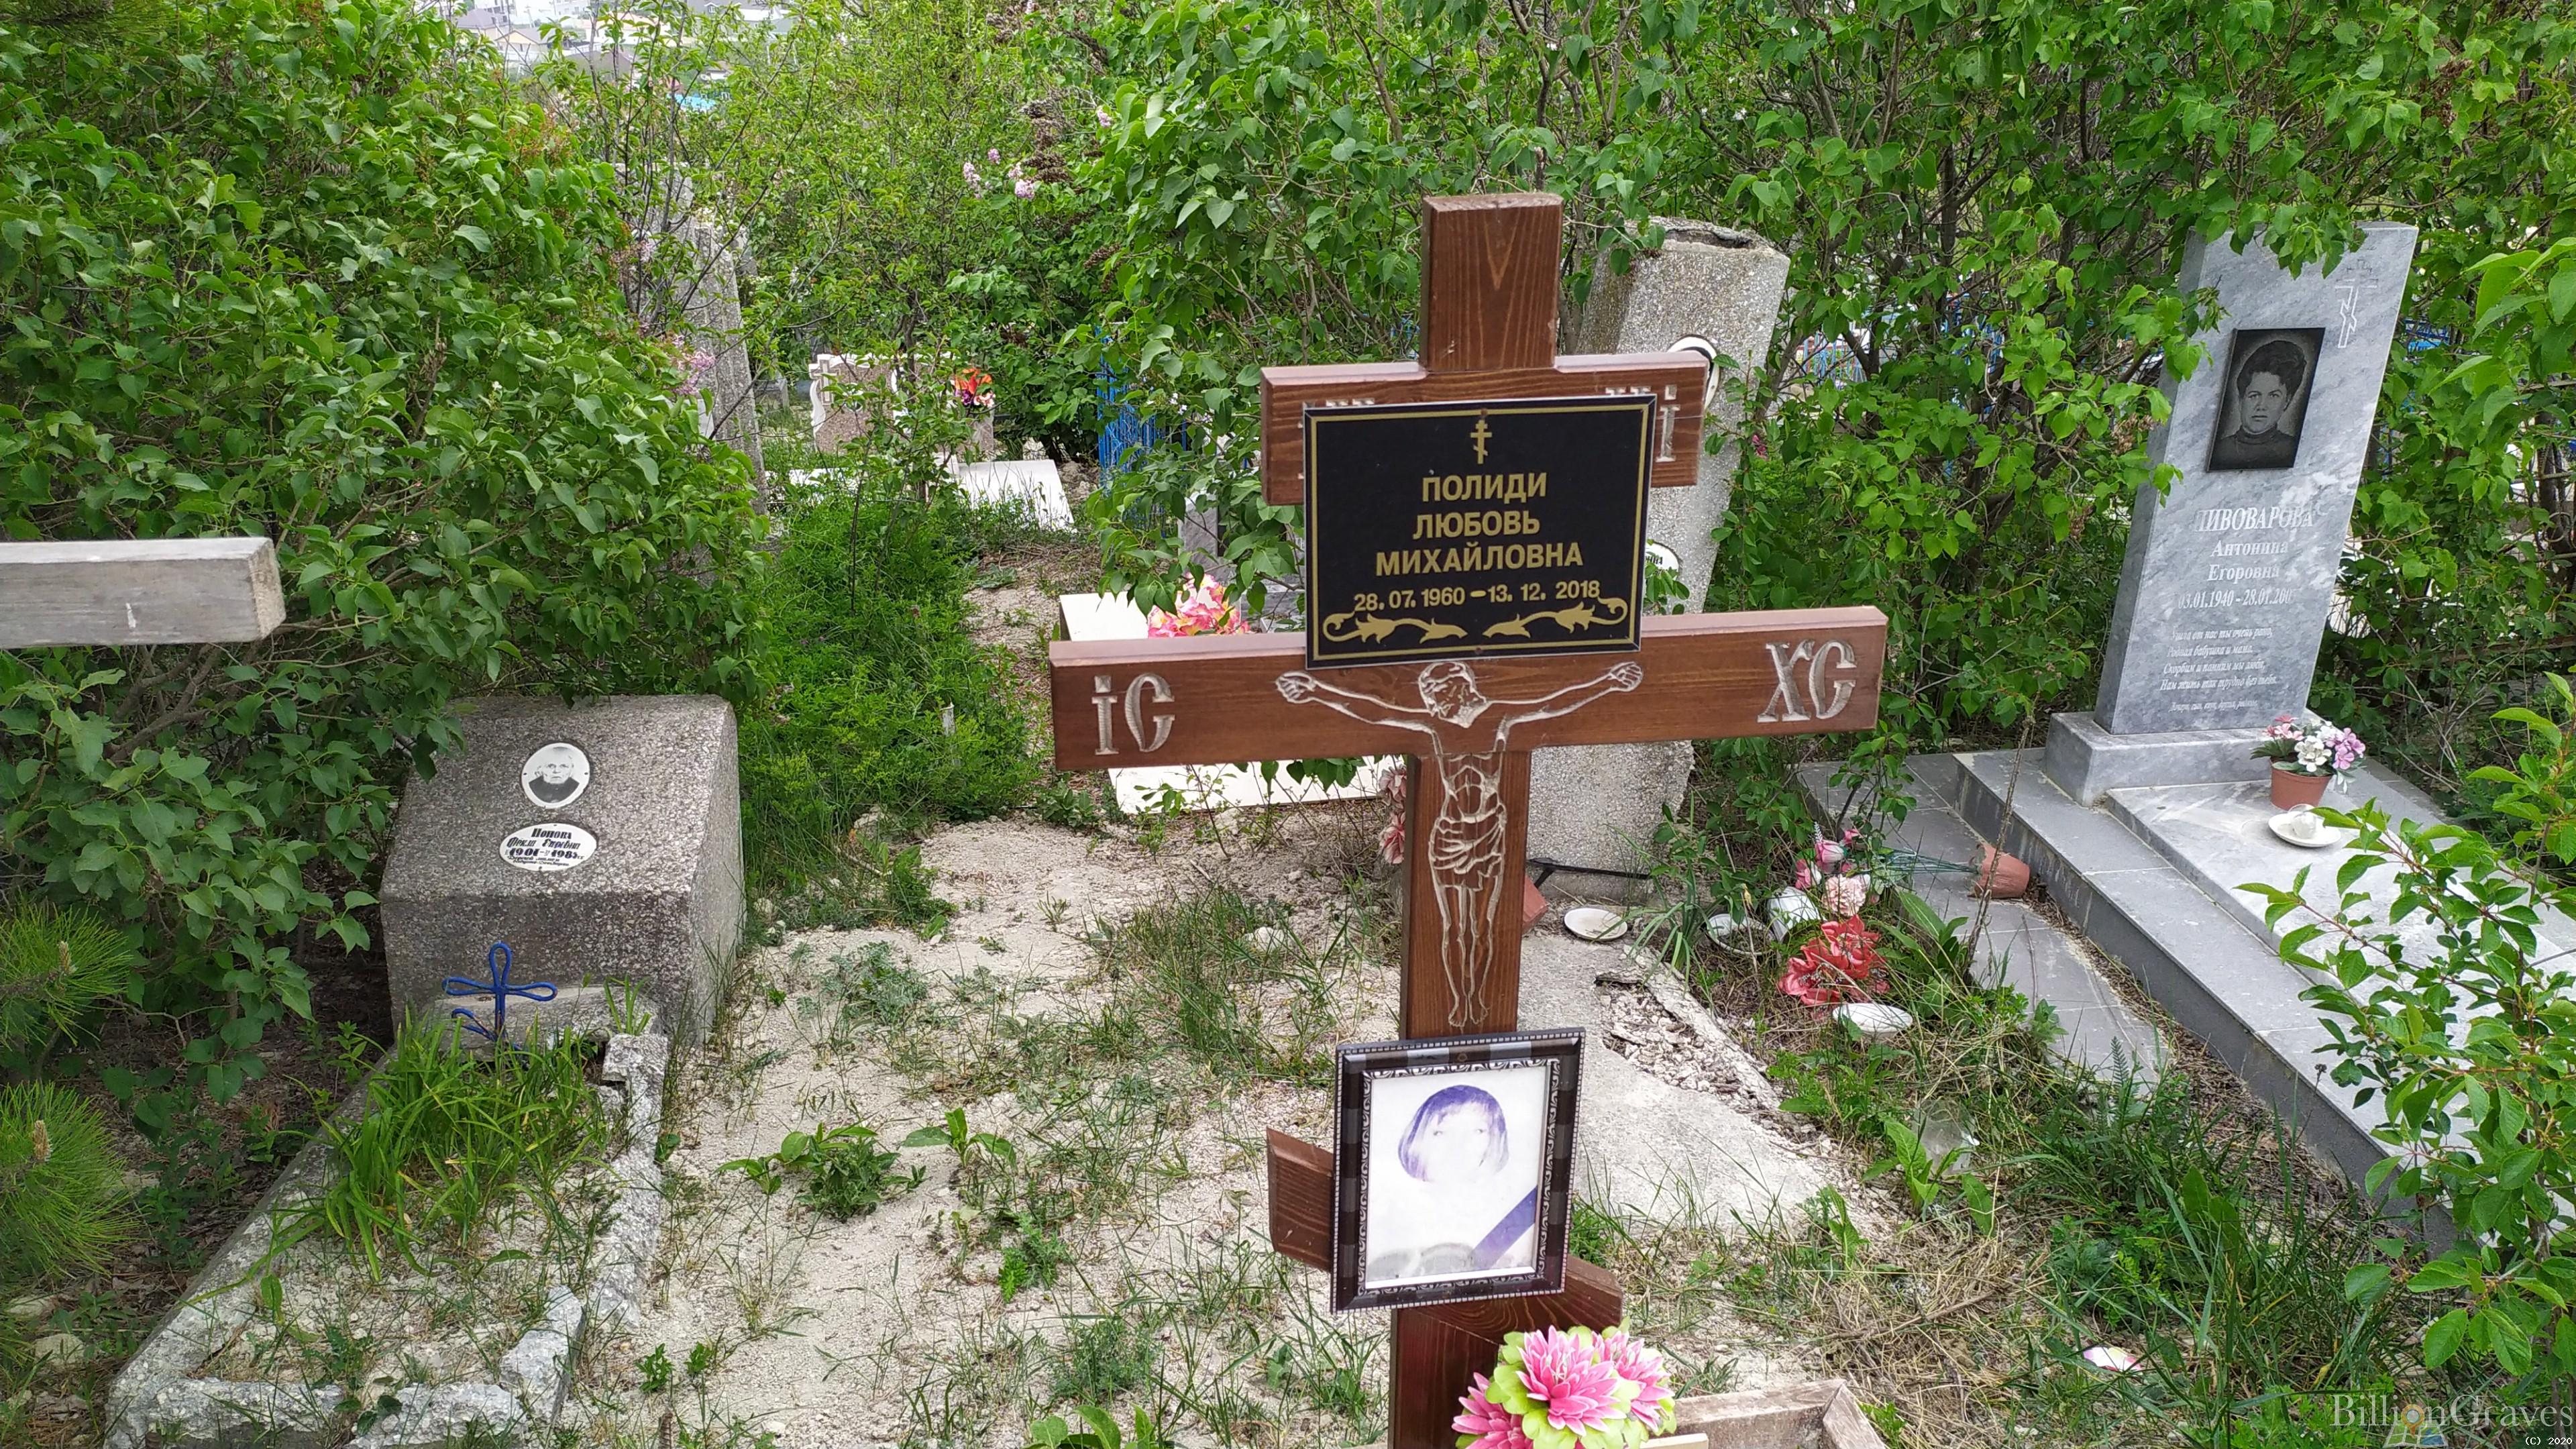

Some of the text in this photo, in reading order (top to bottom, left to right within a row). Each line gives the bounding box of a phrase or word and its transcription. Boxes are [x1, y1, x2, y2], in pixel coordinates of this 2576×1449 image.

[1422, 472, 1547, 504] ПОЛИДИ
[1413, 511, 1540, 539] ЛЮБОВЬ
[2194, 506, 2314, 532] ПИВОВАРОВА
[2210, 539, 2289, 557] Антонина
[1376, 541, 1584, 576] МИХАЙЛОВНА
[2206, 564, 2280, 584] Егоровна
[1555, 580, 1600, 599] 2018
[2178, 590, 2235, 608] 03.01.1940
[2205, 630, 2218, 639] нас
[2233, 629, 2252, 638] очень
[2194, 645, 2224, 659] бабушка
[2159, 678, 2177, 691] Нам
[2201, 679, 2217, 688] так
[2218, 676, 2245, 690] трудно
